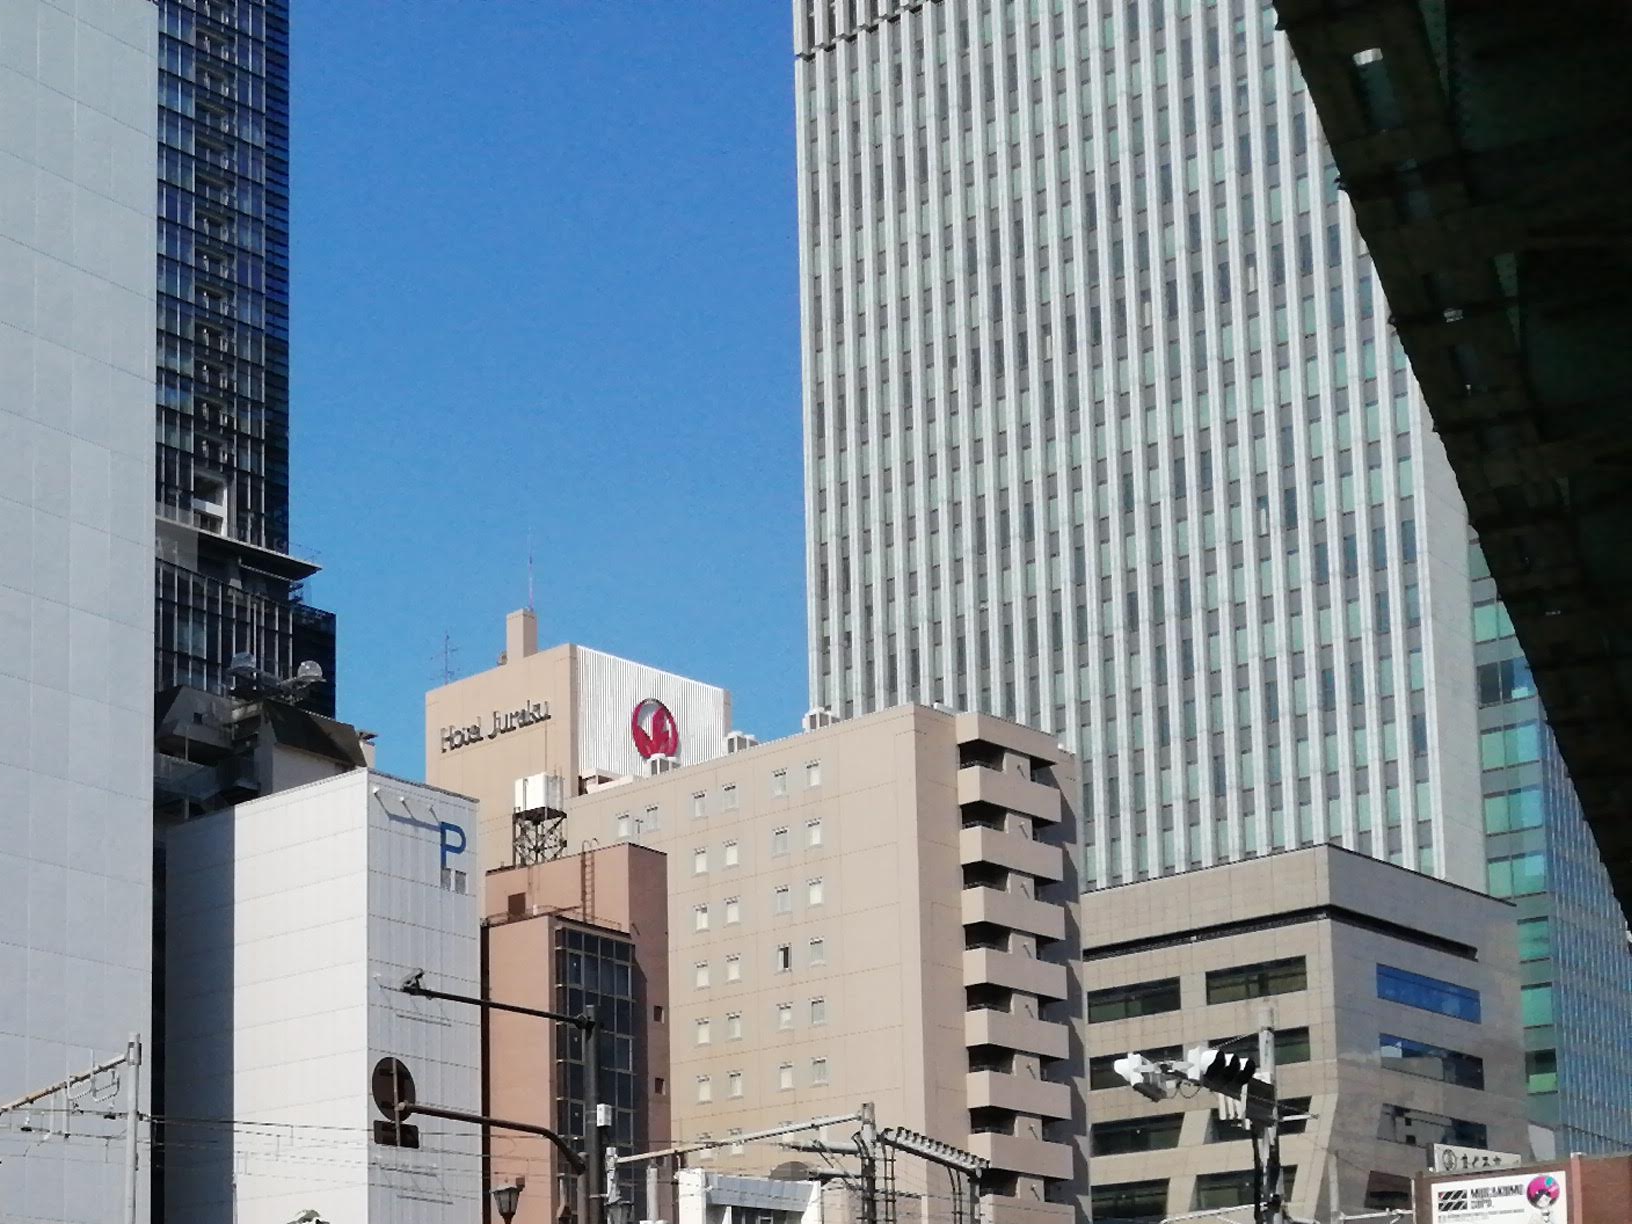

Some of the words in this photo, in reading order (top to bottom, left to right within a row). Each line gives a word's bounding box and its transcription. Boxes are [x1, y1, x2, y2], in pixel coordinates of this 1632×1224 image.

[441, 716, 484, 753] Hotel
[488, 700, 551, 739] Juraku
[440, 822, 466, 869] P
